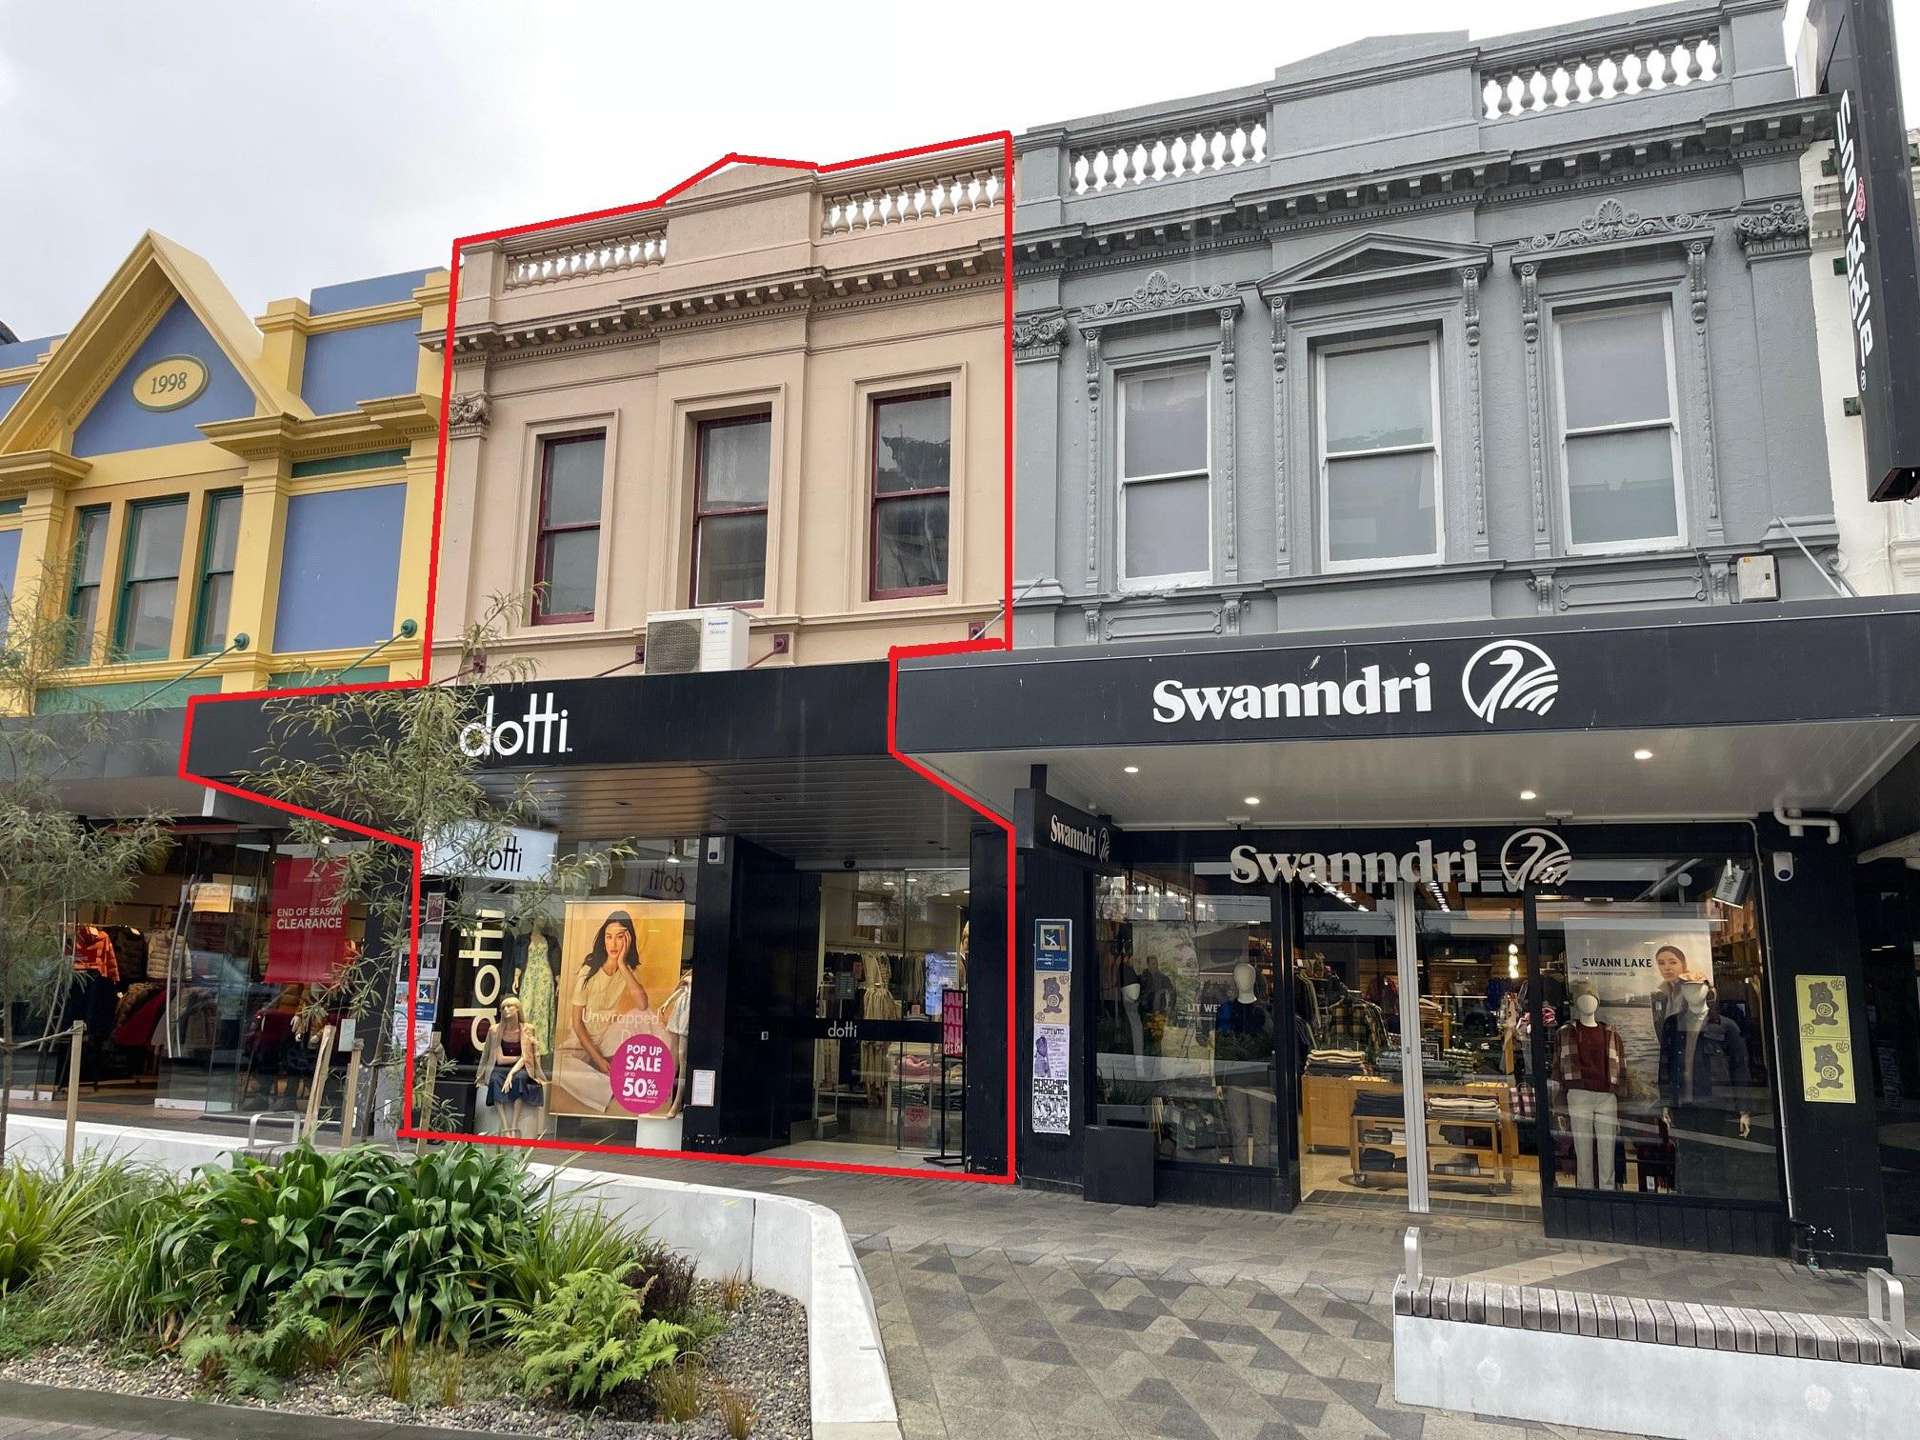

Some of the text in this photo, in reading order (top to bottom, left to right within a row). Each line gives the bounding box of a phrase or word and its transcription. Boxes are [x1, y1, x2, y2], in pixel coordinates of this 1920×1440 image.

[1837, 88, 1873, 367] smiggle
[150, 372, 188, 395] 1998
[1152, 662, 1432, 724] Swanndri
[460, 692, 568, 757] dotti
[1051, 814, 1096, 856] Swanndri
[1230, 838, 1479, 884] Swanndri
[277, 906, 344, 917] END OF SEASON
[276, 918, 342, 930] CLEARANCE
[1582, 957, 1653, 968] SWANN LAKE
[582, 1007, 660, 1028] Unwrapped
[827, 1020, 857, 1038] dotti
[627, 1044, 663, 1056] POP UP
[625, 1056, 662, 1072] SALE
